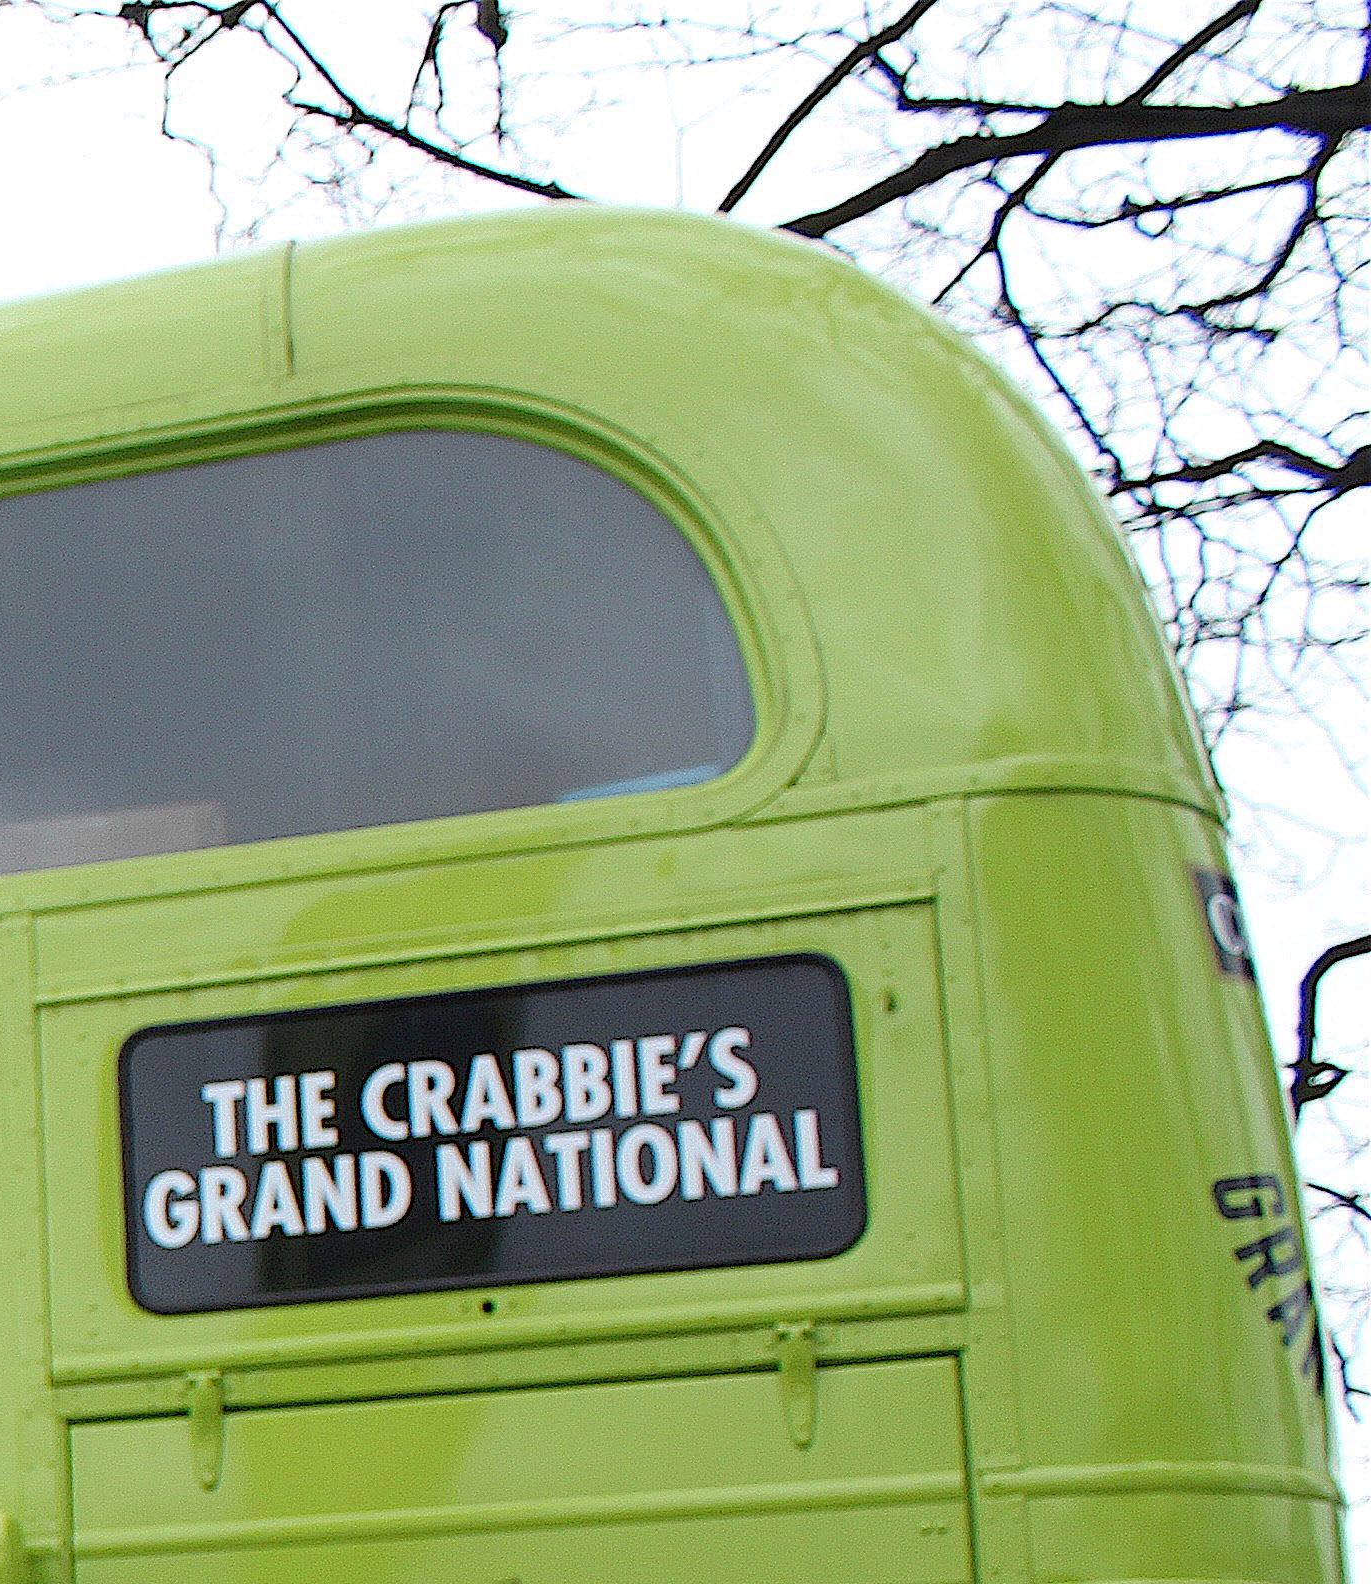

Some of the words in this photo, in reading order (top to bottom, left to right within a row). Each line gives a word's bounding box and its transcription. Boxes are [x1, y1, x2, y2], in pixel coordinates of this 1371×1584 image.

[201, 1069, 339, 1158] THE
[362, 1025, 758, 1142] CRABBIE'S
[143, 1150, 412, 1249] GRAND
[436, 1108, 840, 1220] NATIONAL
